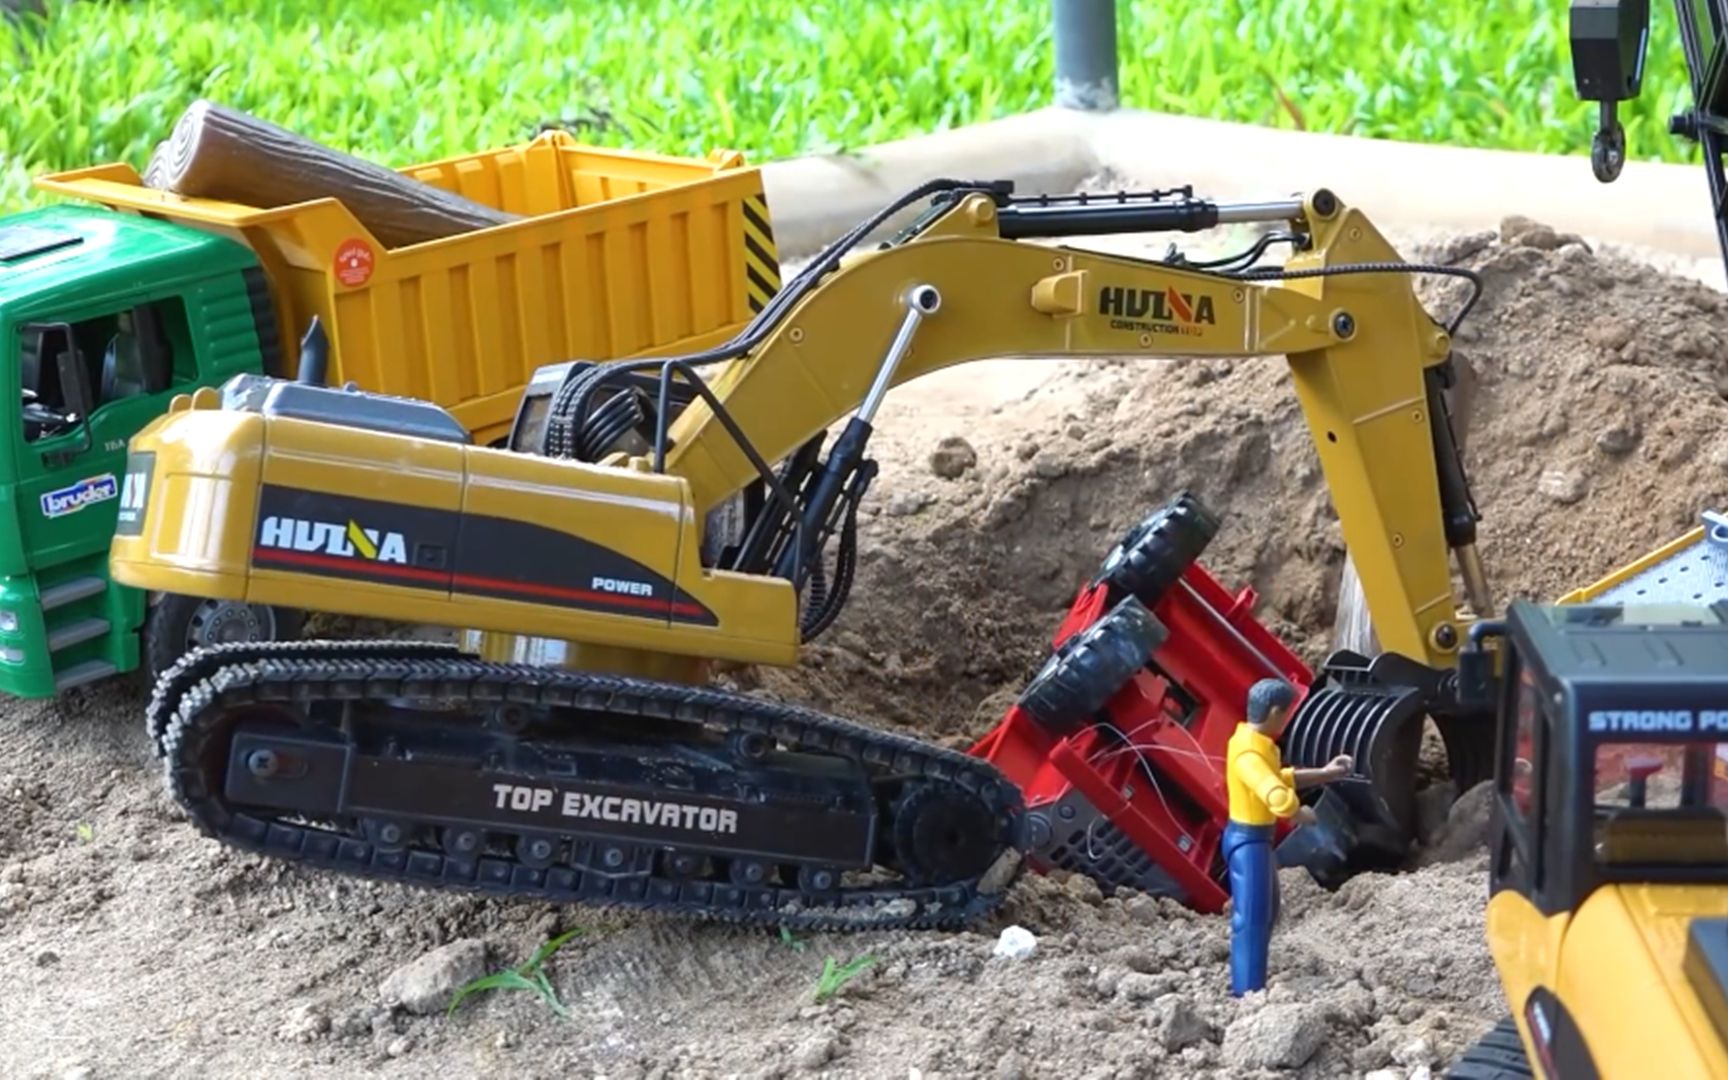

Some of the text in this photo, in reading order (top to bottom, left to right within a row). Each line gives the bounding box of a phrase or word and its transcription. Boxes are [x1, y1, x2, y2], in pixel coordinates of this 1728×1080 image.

[46, 484, 111, 512] bruder
[260, 516, 407, 563] HUINA
[592, 577, 653, 597] POWER
[1588, 711, 1692, 731] STRONG
[493, 784, 738, 833] TOP EXCAVATOR
